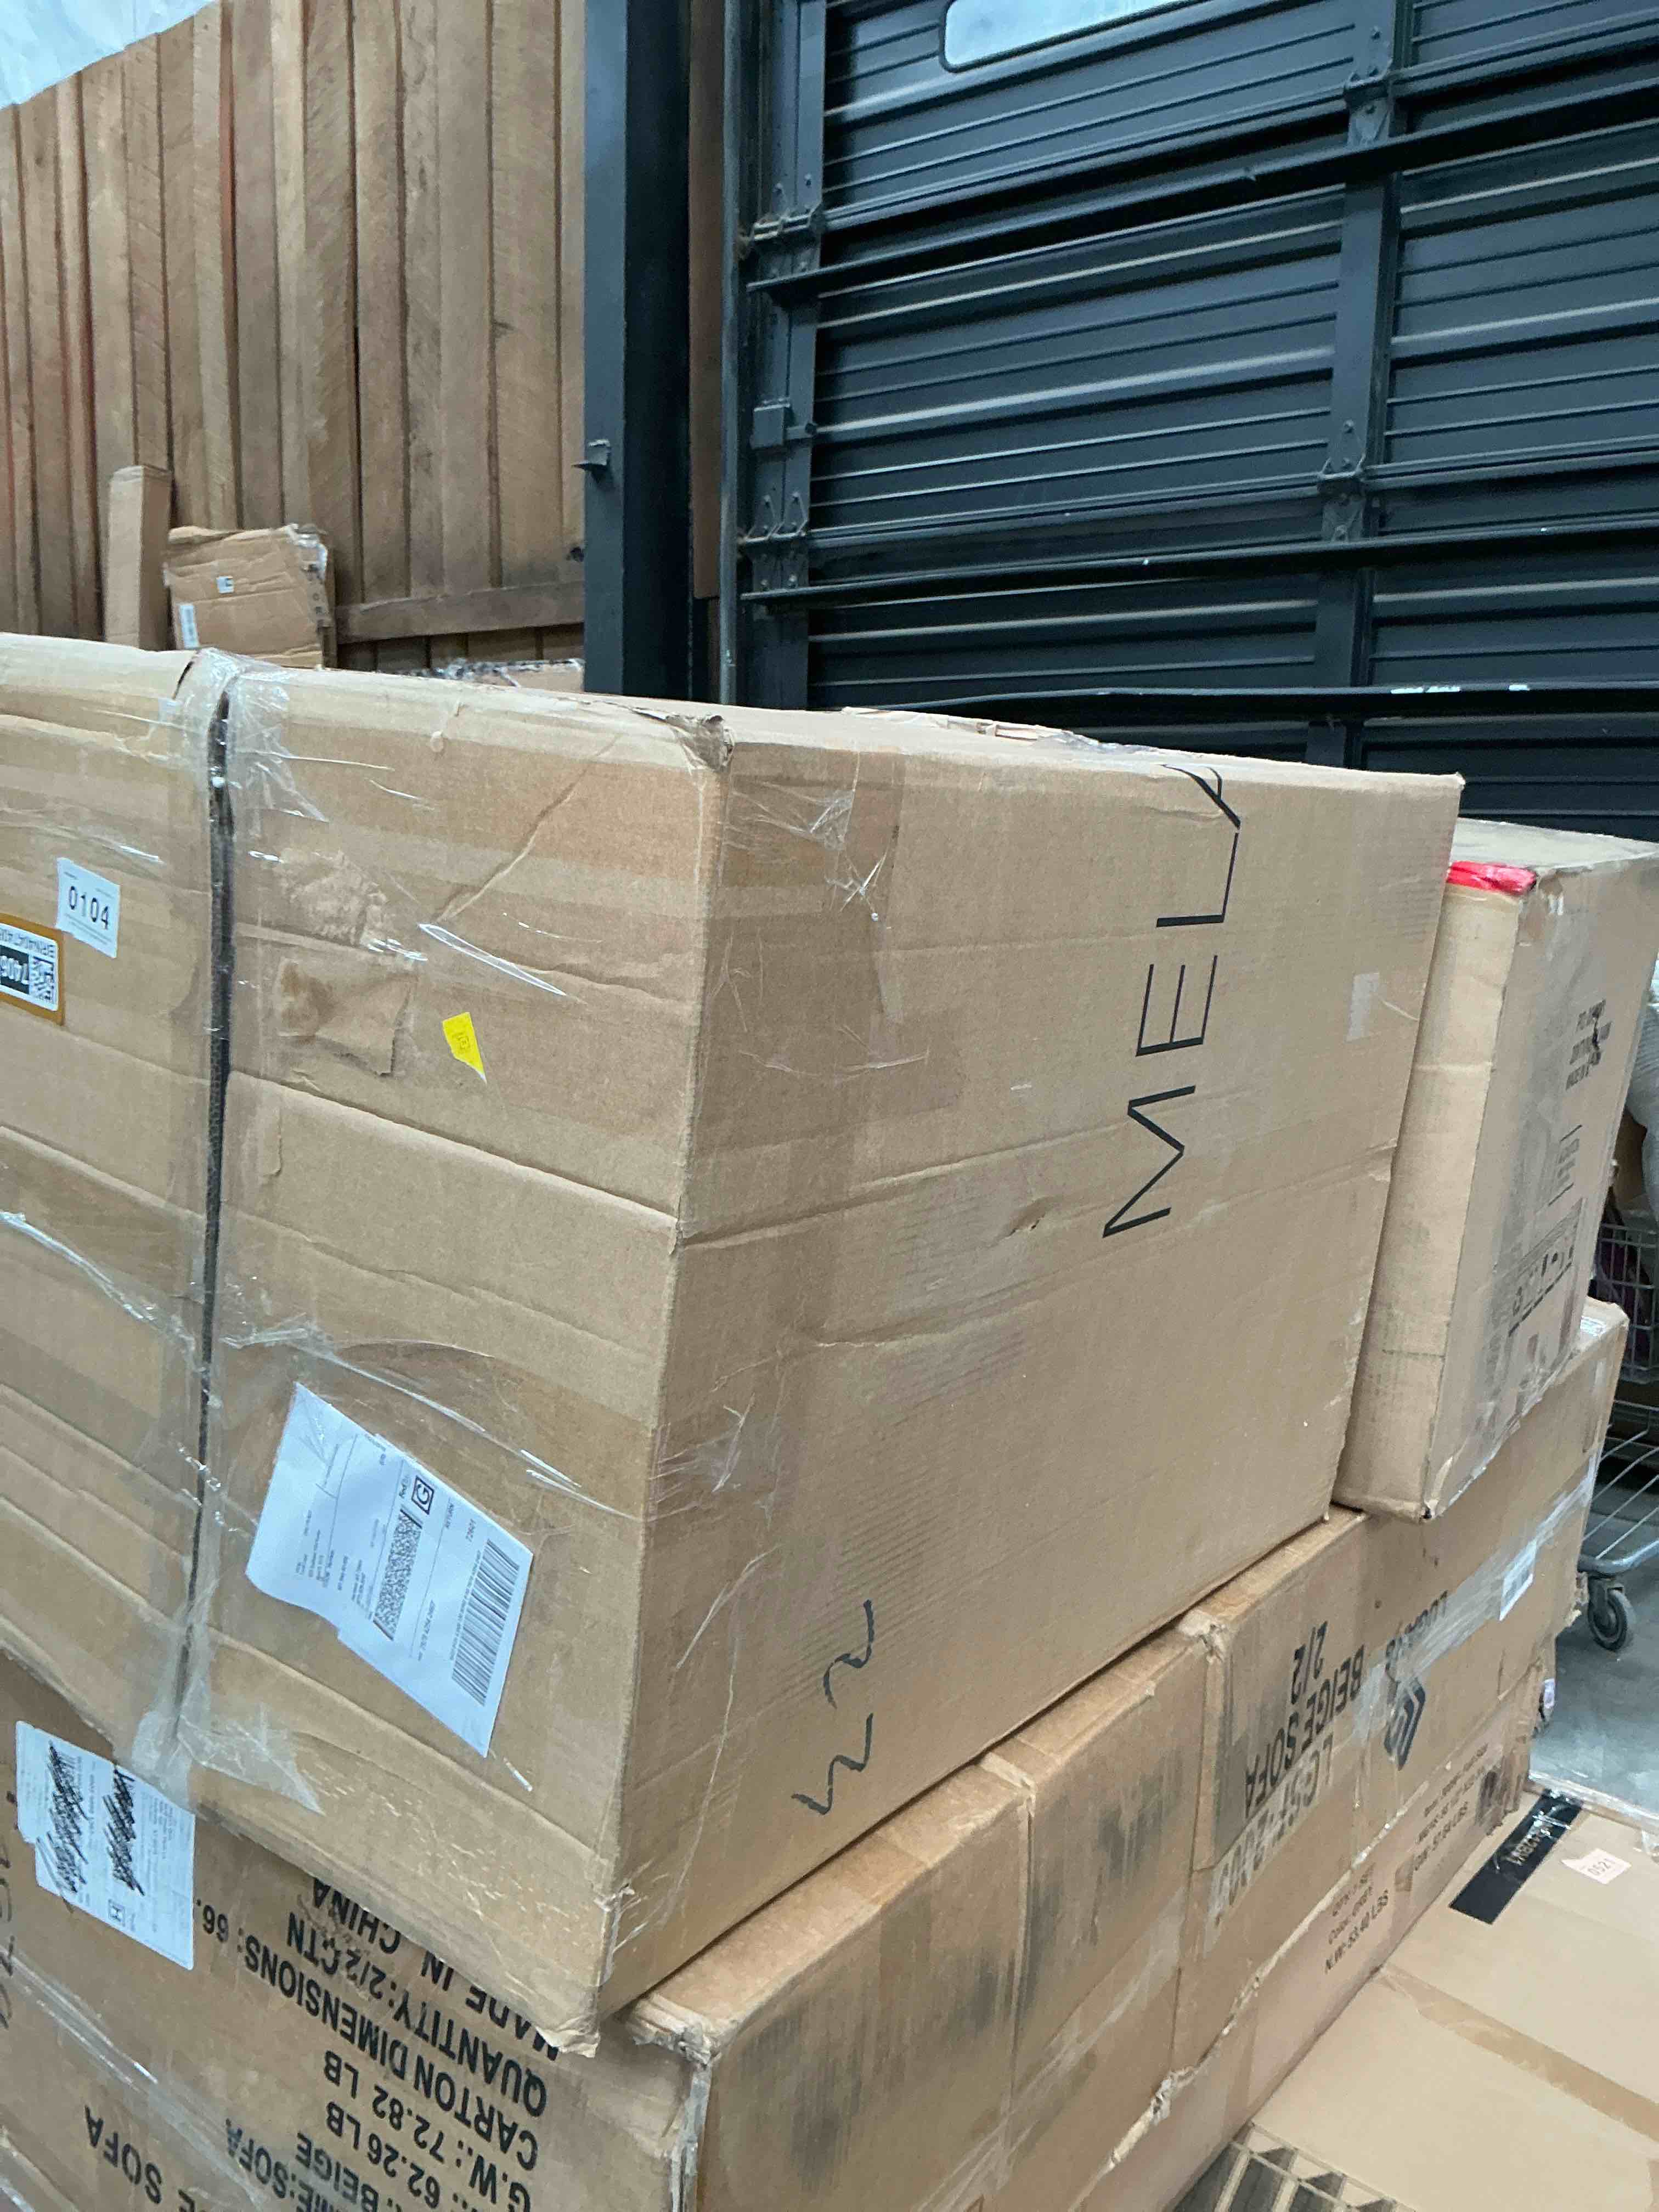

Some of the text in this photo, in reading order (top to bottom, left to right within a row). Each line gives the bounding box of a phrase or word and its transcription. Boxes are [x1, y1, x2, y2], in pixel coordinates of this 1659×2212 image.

[69, 885, 109, 930] 0104
[1290, 1620, 1328, 1705] 2/2
[1244, 1644, 1365, 1819] BEIGE SOFA
[313, 1877, 400, 1955] CHINA
[420, 1950, 455, 1991] IN
[324, 2050, 359, 2100] LB
[413, 2054, 538, 2171] CARTON
[84, 2105, 162, 2205] SOFA
[326, 2101, 441, 2209] 62.26 LB
[371, 2084, 445, 2164] 72.82
[295, 2130, 379, 2212] BEIGE
